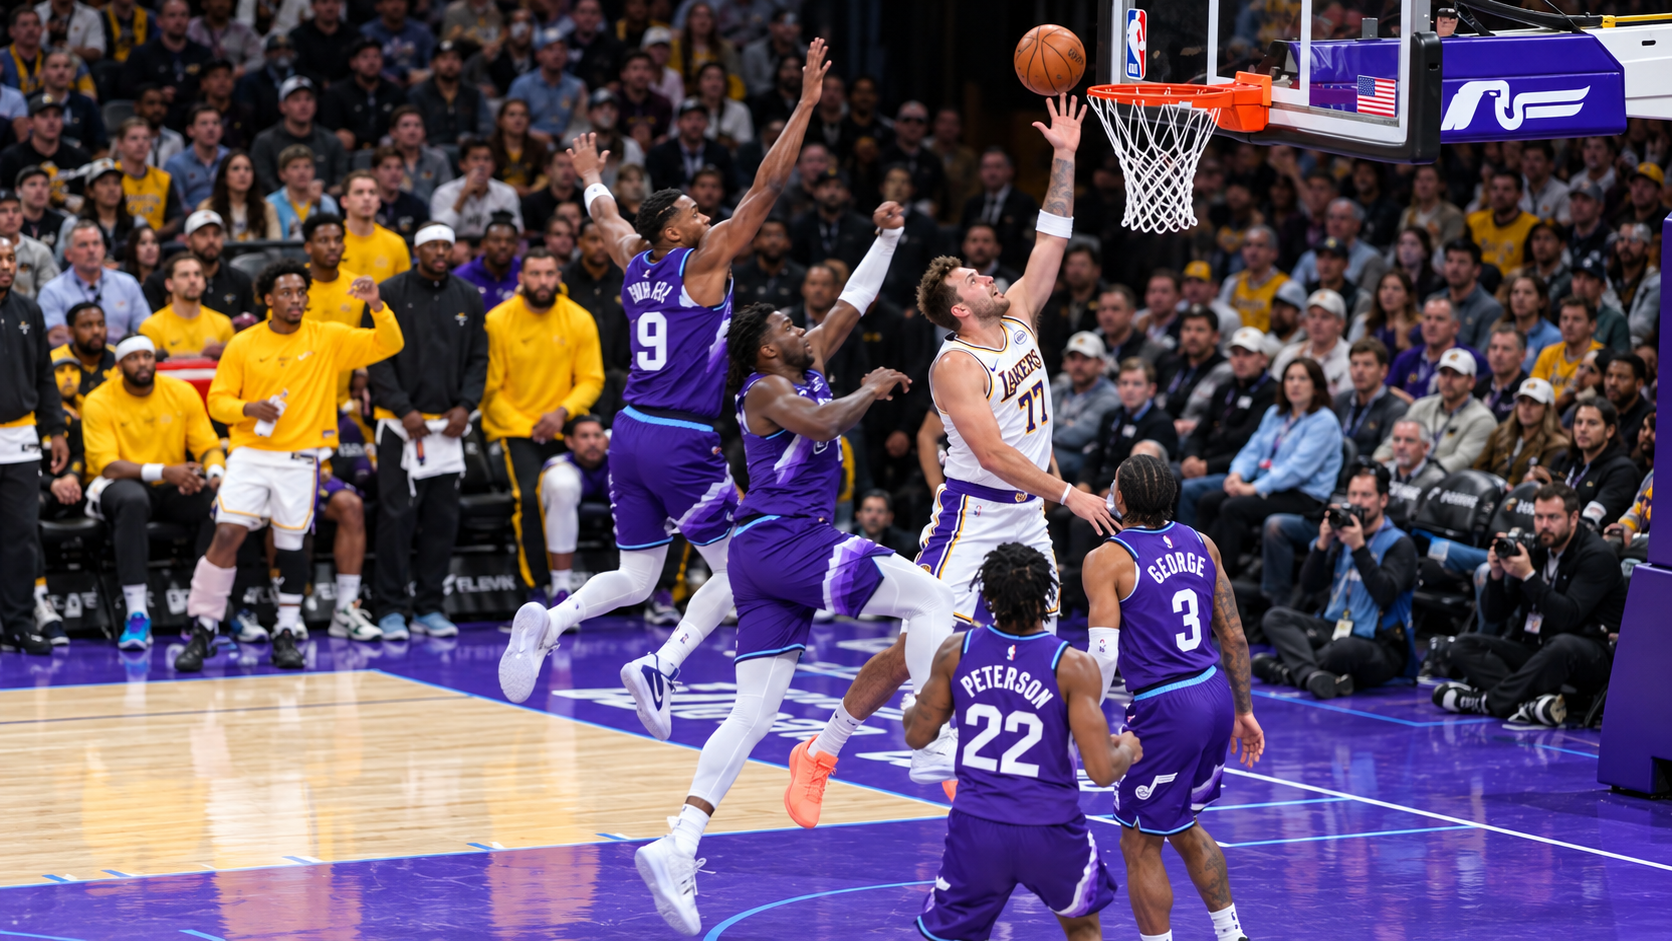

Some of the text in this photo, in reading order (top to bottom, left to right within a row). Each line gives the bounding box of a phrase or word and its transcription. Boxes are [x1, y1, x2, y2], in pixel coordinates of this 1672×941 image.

[637, 311, 667, 371] 9
[998, 348, 1042, 403] LAKERS
[1018, 379, 1048, 435] 77
[1147, 551, 1206, 584] GEORGE
[1172, 588, 1202, 652] 3
[960, 665, 1054, 710] PETERSON
[961, 702, 1044, 778] 22
